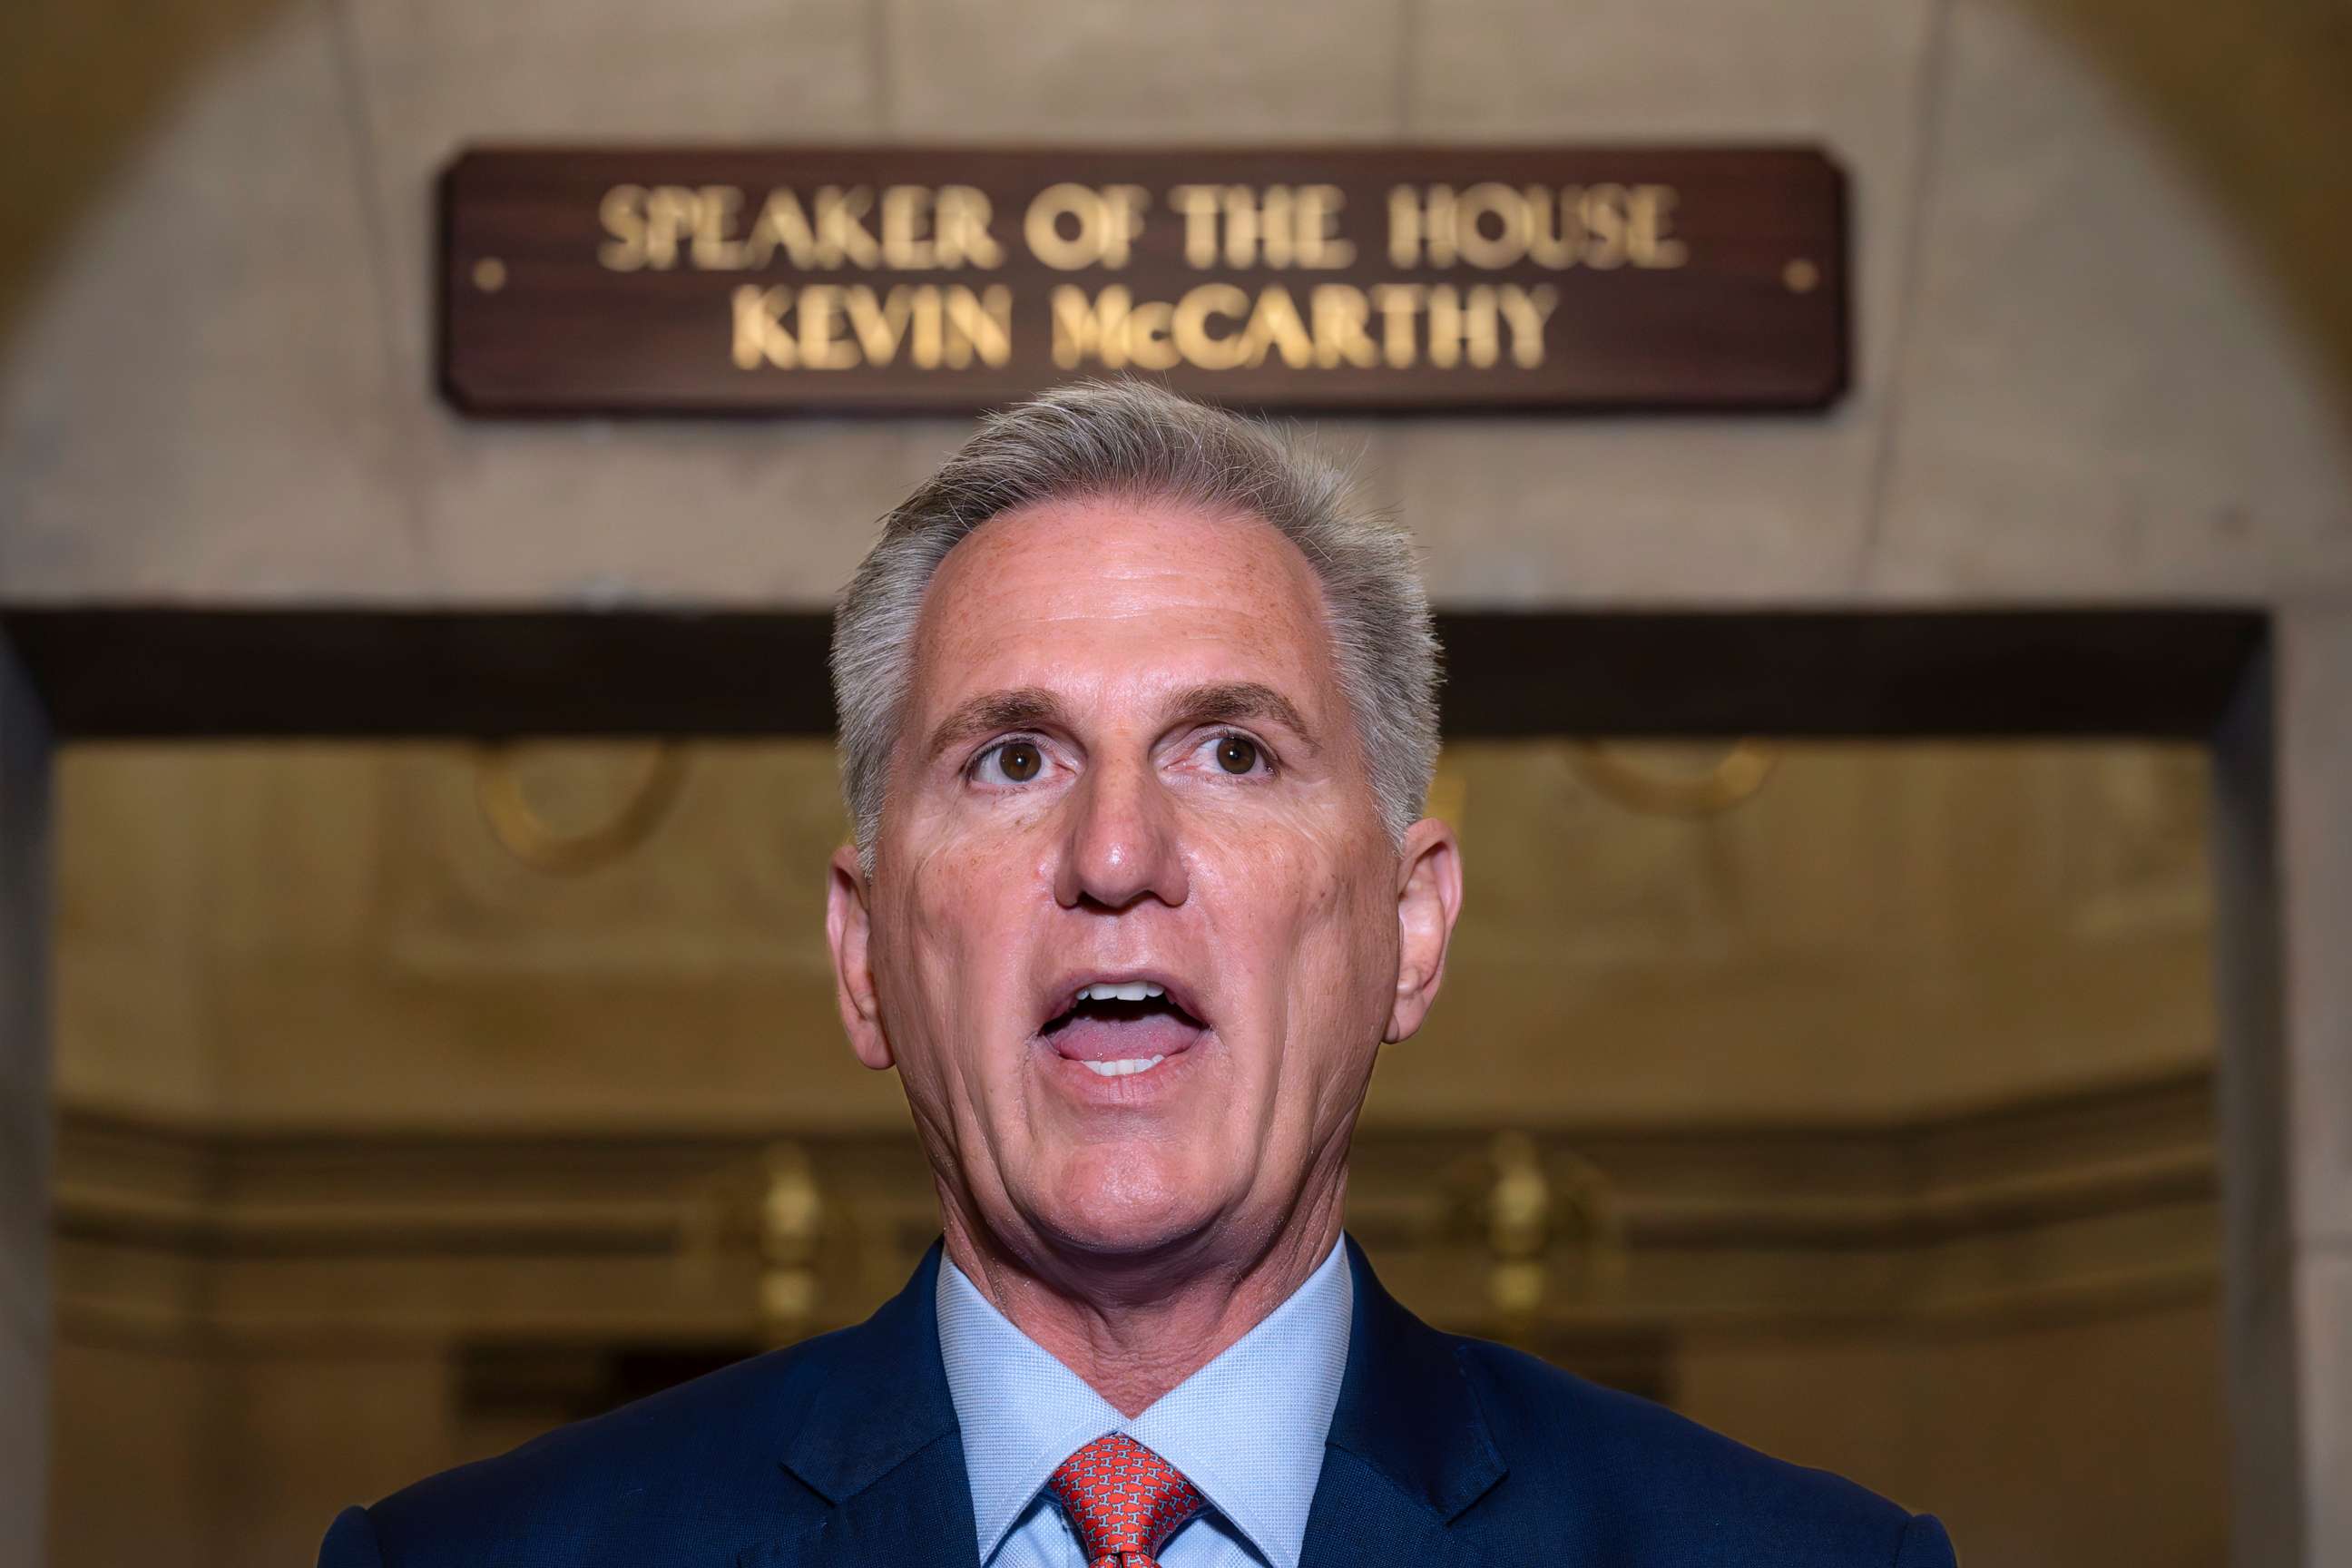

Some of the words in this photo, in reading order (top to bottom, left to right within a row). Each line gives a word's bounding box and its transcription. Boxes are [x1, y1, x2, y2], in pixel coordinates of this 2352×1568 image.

[598, 183, 1006, 271] SPEAKER
[1024, 183, 1152, 270] OF
[1169, 183, 1357, 270] THE
[1387, 182, 1688, 270] HOUSE
[730, 283, 1013, 370] KEVIN
[1050, 282, 1558, 370] McCARTHY
